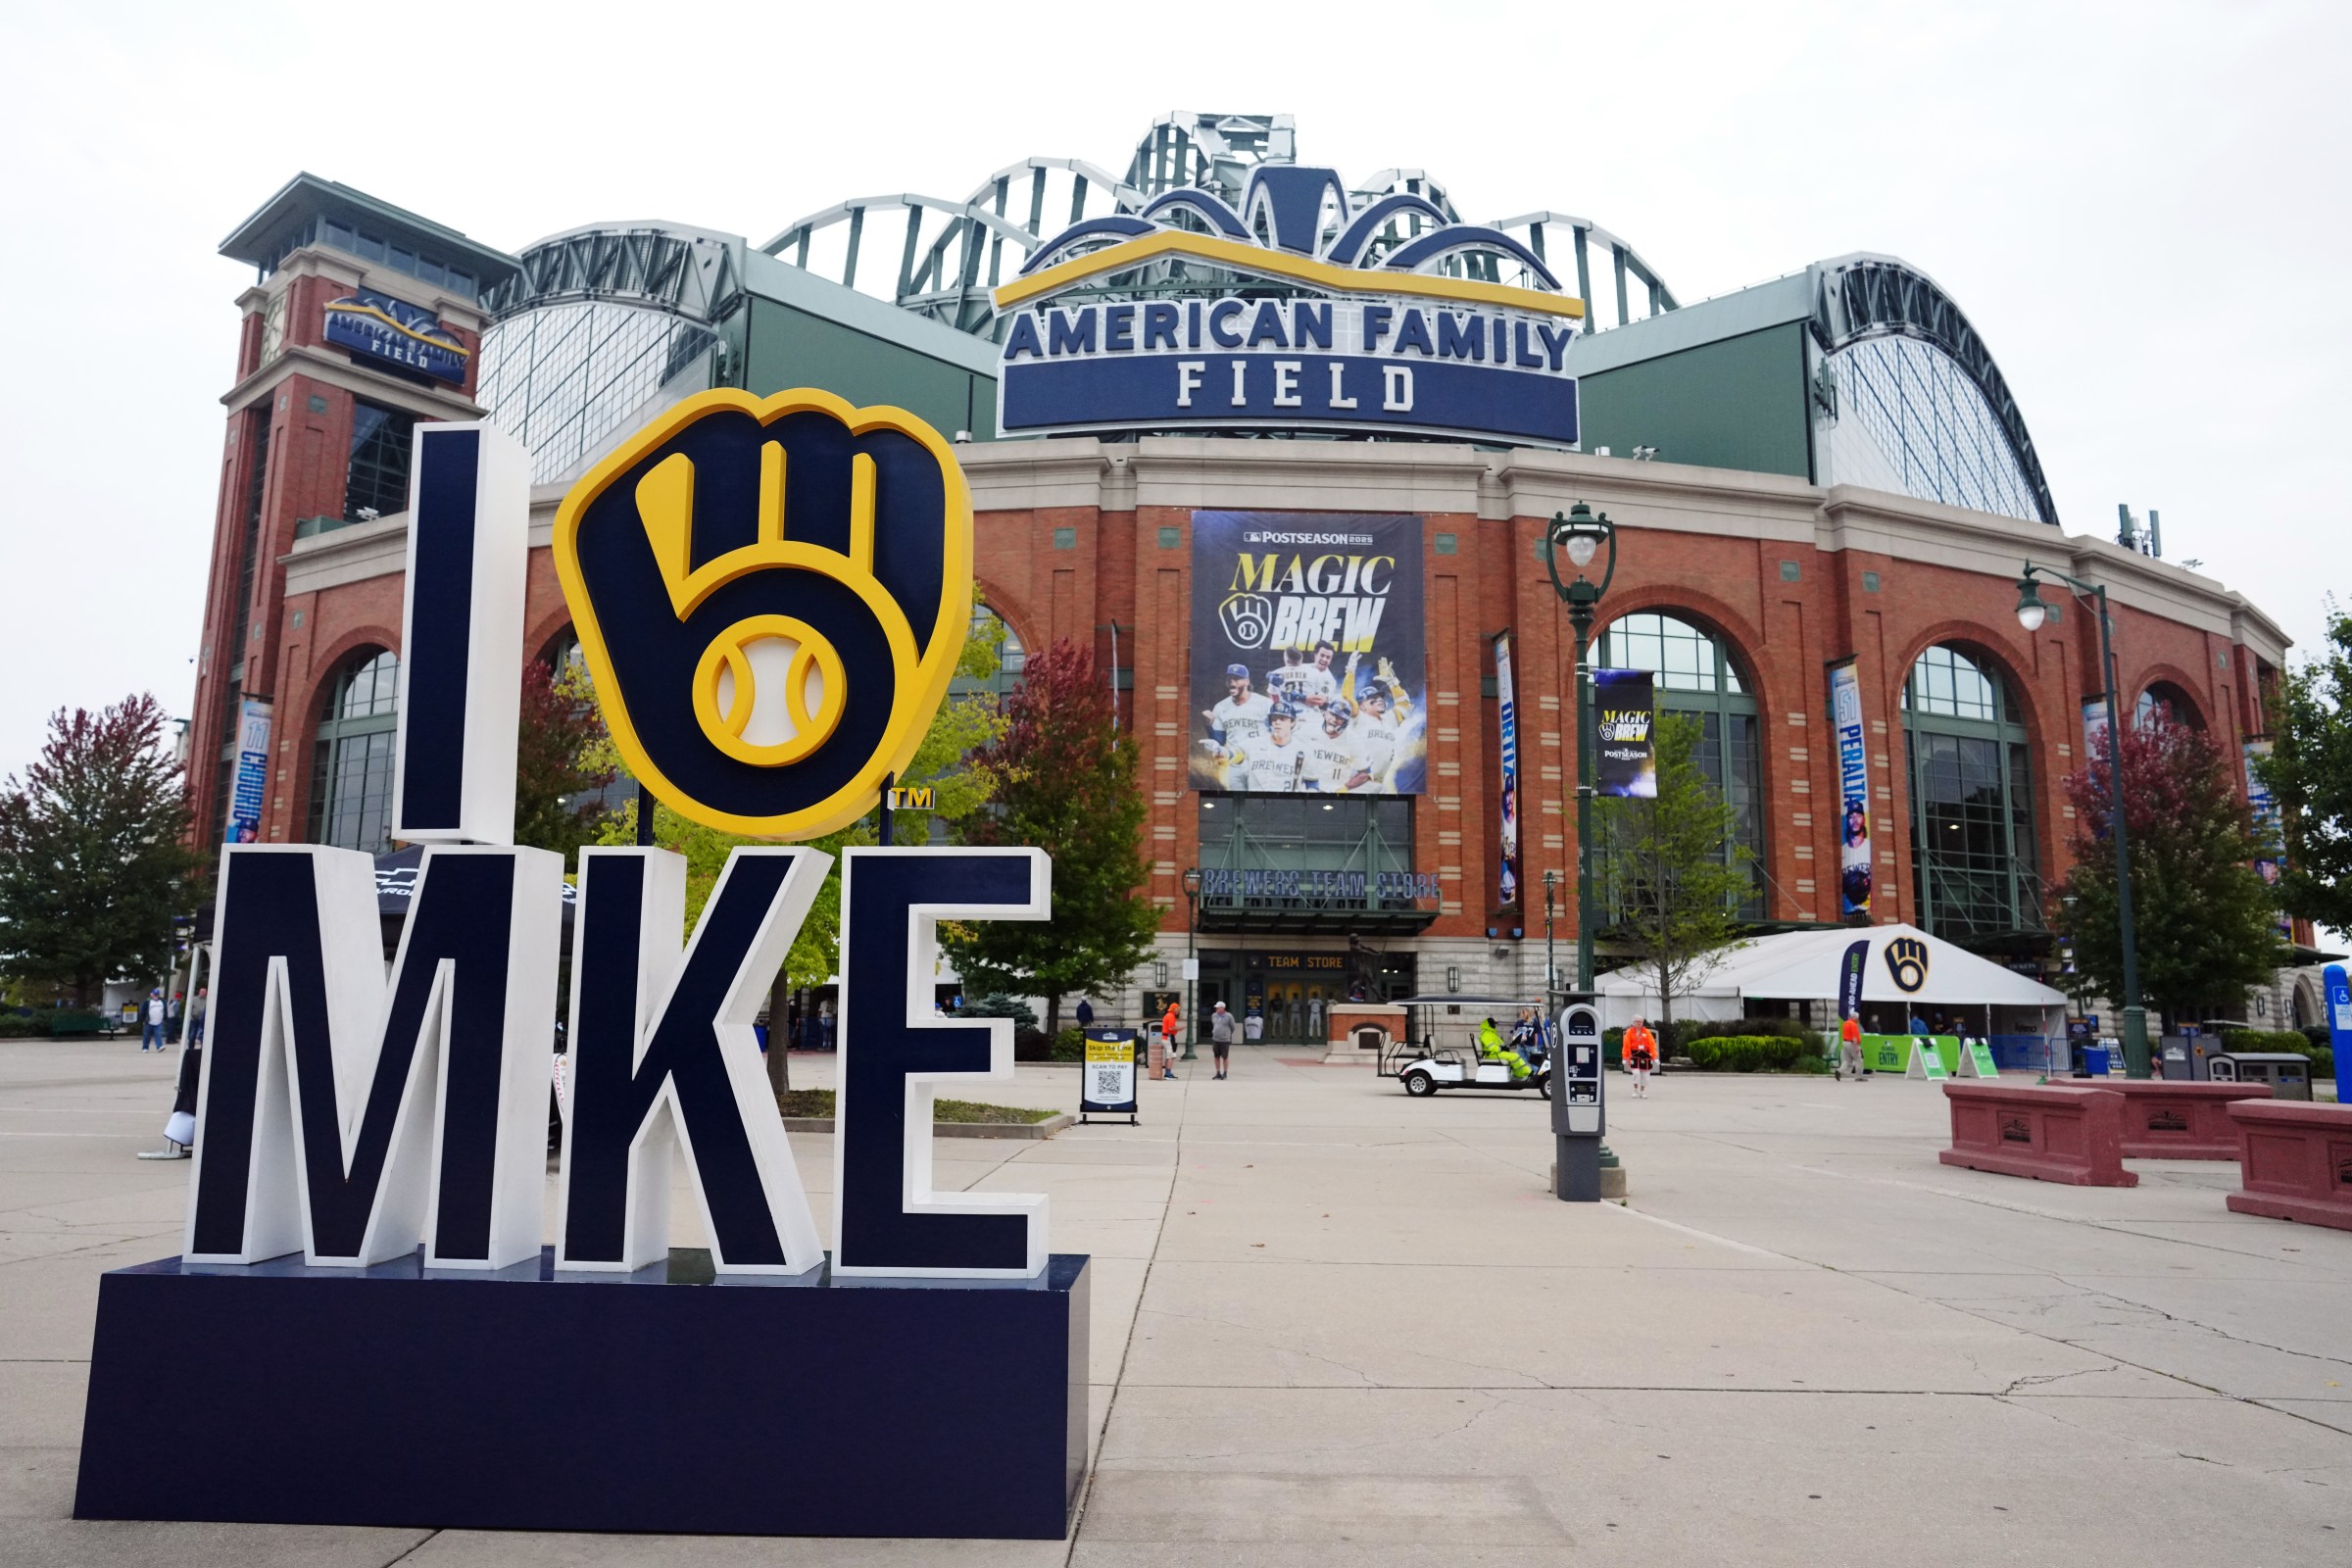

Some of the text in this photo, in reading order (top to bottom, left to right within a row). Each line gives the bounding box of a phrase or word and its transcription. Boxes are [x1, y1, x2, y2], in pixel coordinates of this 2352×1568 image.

[328, 312, 409, 350] AMERICAN
[1004, 300, 1574, 371] AMERICAN FAMILY
[370, 339, 428, 368] FIELD
[1176, 360, 1414, 414] FIELD
[1262, 531, 1348, 545] POSTSEASON
[1229, 553, 1396, 595] MAGIC
[1270, 595, 1387, 653] BREW
[1601, 710, 1651, 724] MAGIC
[1838, 687, 1857, 723] 51
[246, 721, 269, 750] 11
[1501, 701, 1515, 784] ORTIZ
[1613, 723, 1649, 742] BREW
[1604, 750, 1647, 759] POSTSEASON
[1839, 723, 1867, 808] PERALTA
[233, 751, 268, 824] CHOURIO
[891, 787, 932, 808] TM
[1203, 868, 1440, 900] BREWERS TEAM STORE
[1268, 956, 1344, 968] TEAM STORE
[1848, 972, 1858, 1005] GO-AHEAD
[182, 845, 1051, 1278] MKE
[1879, 1052, 1898, 1066] ENTRY
